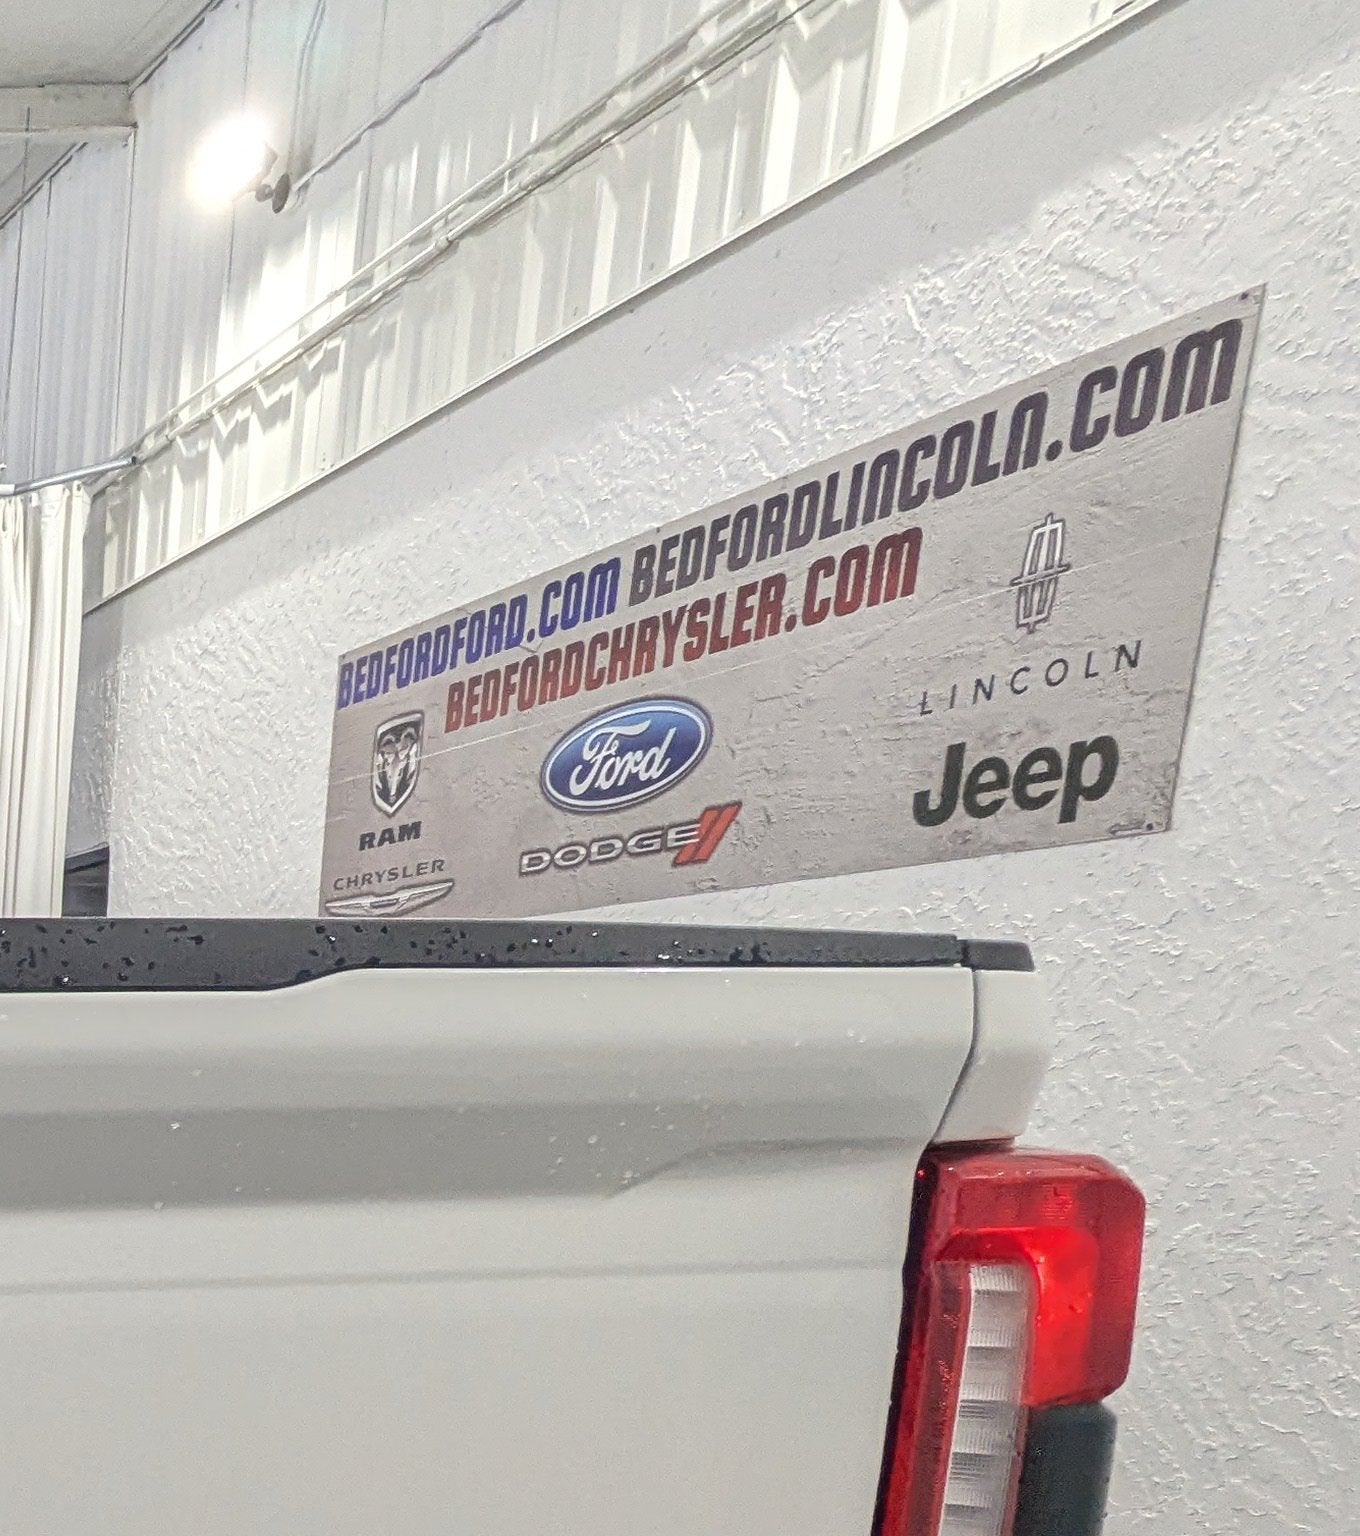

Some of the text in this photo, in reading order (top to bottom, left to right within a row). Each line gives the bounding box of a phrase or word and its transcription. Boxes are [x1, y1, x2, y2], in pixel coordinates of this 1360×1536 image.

[337, 317, 1245, 711] BEDFORDFORD.COM BEDFORDLINCOLN.COM
[444, 526, 924, 734] BEDFORDCHRYSLER.COM
[918, 639, 1143, 718] LINCOLN
[568, 719, 678, 797] Ford
[911, 734, 1121, 828] Jeep
[332, 858, 446, 892] CHRYSLER
[358, 820, 423, 852] RAM
[518, 821, 705, 878] DODGE
